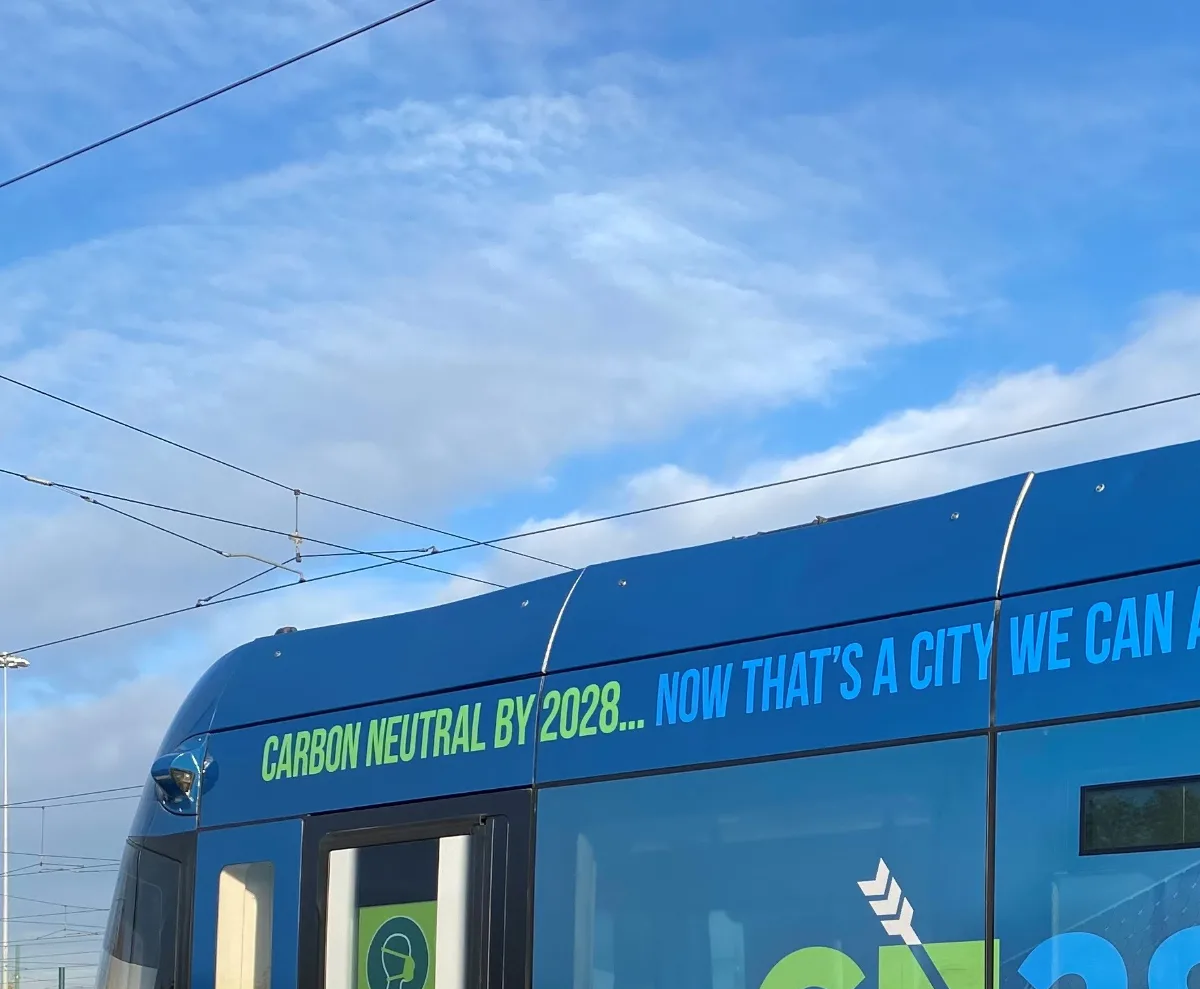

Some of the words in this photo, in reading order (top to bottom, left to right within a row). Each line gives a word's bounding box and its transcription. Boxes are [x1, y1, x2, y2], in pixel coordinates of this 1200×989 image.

[261, 721, 362, 782] CARBON
[365, 703, 486, 767] NEUTRAL
[494, 694, 536, 748] BY
[540, 680, 645, 742] 2028...
[655, 663, 733, 726] NOW
[742, 642, 863, 714] THAT'S
[872, 637, 898, 696] A
[910, 620, 995, 690] CITY
[1009, 607, 1073, 675] WE
[1085, 590, 1175, 665] CAN
